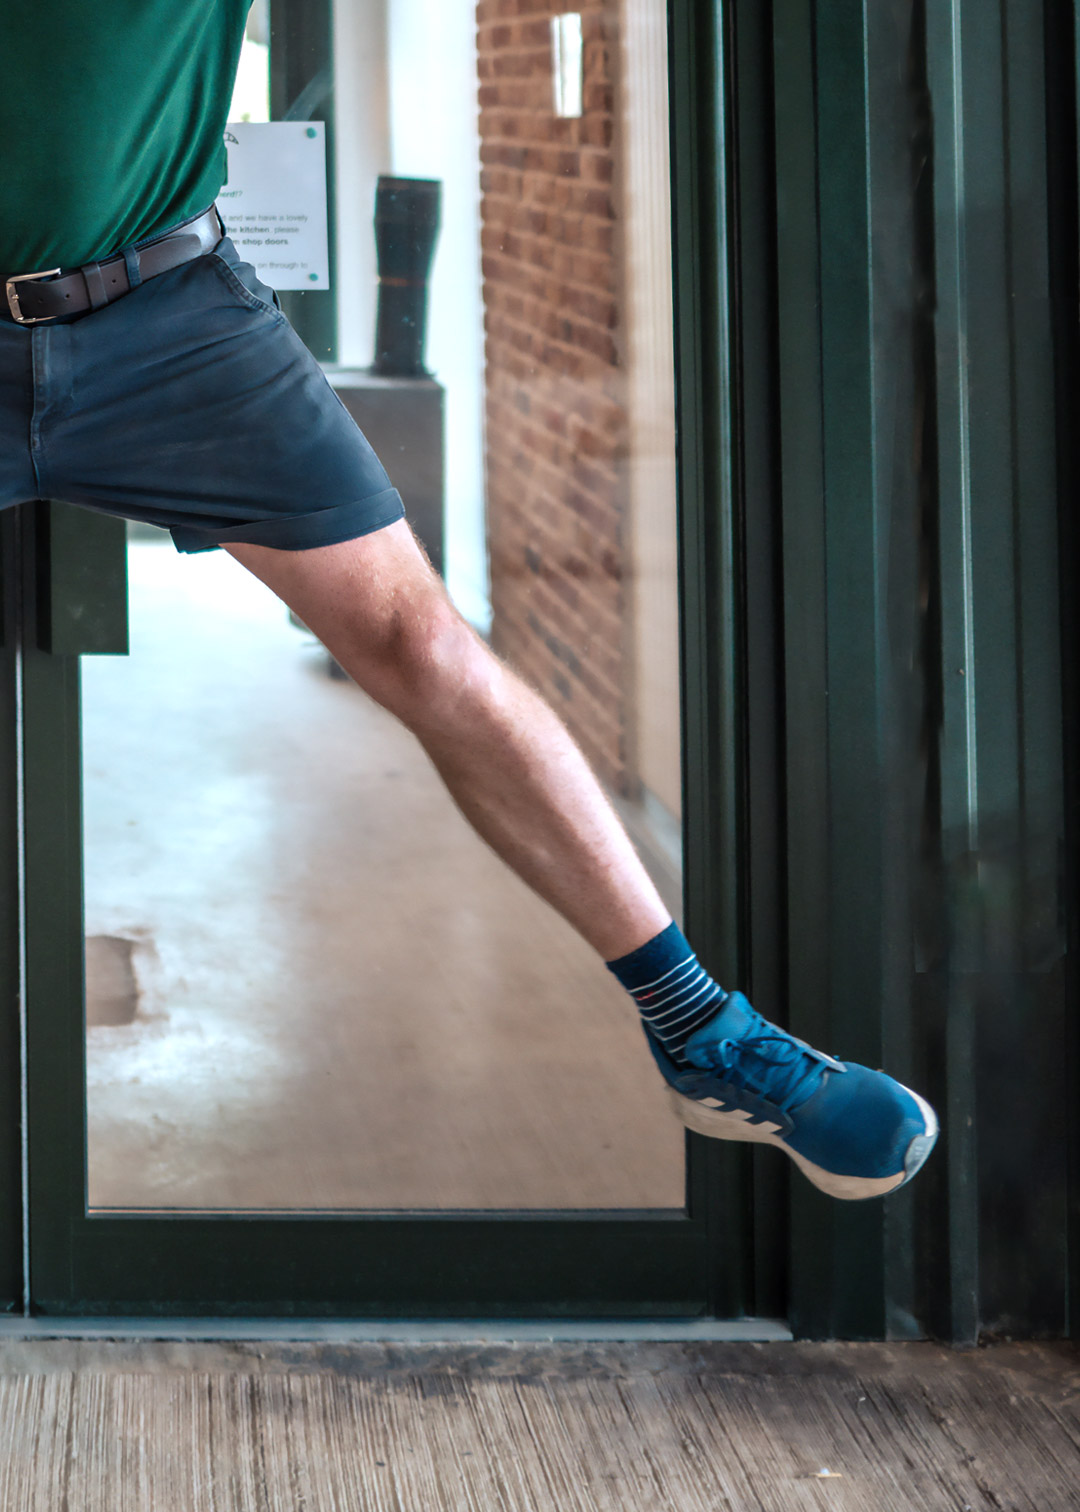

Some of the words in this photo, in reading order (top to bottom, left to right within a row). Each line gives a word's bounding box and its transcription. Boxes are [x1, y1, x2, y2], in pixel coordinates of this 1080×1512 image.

[258, 214, 277, 222] have
[286, 214, 309, 224] lovely
[274, 226, 300, 235] please
[242, 238, 263, 247] shop
[265, 238, 288, 246] doors
[269, 261, 299, 271] through
